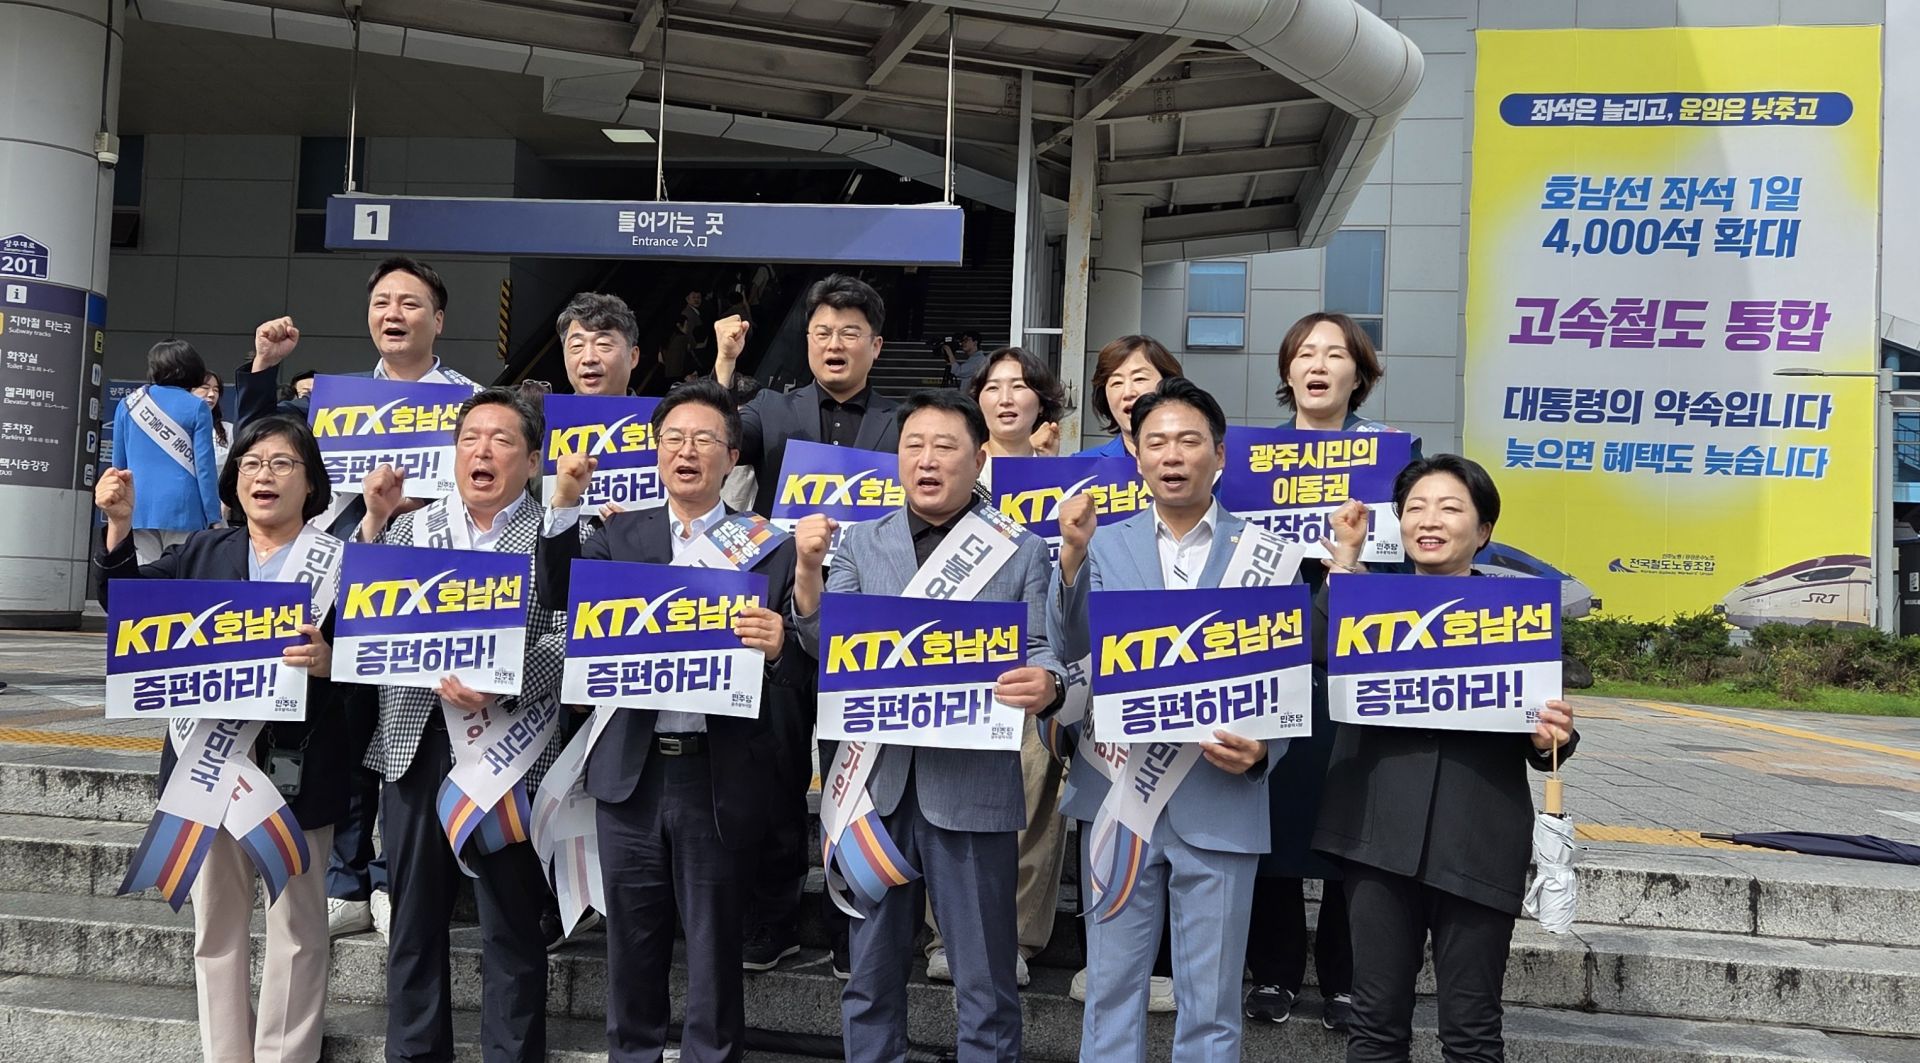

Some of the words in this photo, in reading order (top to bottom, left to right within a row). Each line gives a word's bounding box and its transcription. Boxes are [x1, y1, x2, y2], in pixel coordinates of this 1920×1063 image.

[1531, 98, 1597, 122] 좌석은
[1602, 98, 1674, 122] 늘리고,
[1679, 98, 1746, 122] 운임은
[1751, 96, 1819, 122] 낮추고
[1541, 175, 1653, 211] 호남선
[1660, 176, 1737, 213] 좌석
[1748, 176, 1803, 212] 1일
[366, 209, 379, 235] 1
[618, 211, 695, 233] 들어가는
[705, 212, 724, 235] 곳
[632, 235, 679, 247] Entrance
[683, 235, 708, 248] 入口
[1541, 217, 1704, 259] 4,000석
[1713, 217, 1802, 259] 확대
[4, 239, 36, 249] 상무대로
[1, 255, 37, 275] 201
[10, 315, 40, 328] 지하철
[45, 319, 72, 334] 타는곳
[1508, 297, 1711, 350] 고속철도
[1724, 299, 1833, 353] 통합
[7, 350, 38, 364] 화장실
[4, 386, 55, 401] 엘리베이터
[1503, 386, 1645, 425] 대통령의
[1654, 390, 1832, 430] 약속입니다
[2, 422, 34, 436] 주차장
[312, 397, 409, 438] KTX
[389, 402, 464, 434] 호남선
[548, 413, 638, 461] KTX
[1249, 437, 1378, 473] 광주시민의
[1505, 437, 1595, 471] 늦으면
[1603, 441, 1694, 474] 혜택도
[1704, 445, 1829, 479] 늦습니다
[578, 472, 666, 506] 편하라
[780, 468, 879, 505] KTX
[999, 475, 1099, 524] KTX
[1272, 473, 1350, 504] 이동권
[1630, 558, 1716, 572] 전국철도노동조합
[343, 568, 458, 620] KTX
[436, 575, 522, 613] 호남선
[572, 586, 688, 640] KTX
[666, 595, 760, 632] 호남선
[1801, 592, 1840, 604] SRT
[114, 600, 233, 657] KTX
[212, 603, 304, 645] 호남선
[825, 619, 942, 674] KTX
[922, 624, 1019, 666] 호남선
[1099, 609, 1223, 677] KTX
[1202, 608, 1303, 661] 호남선
[1335, 597, 1465, 657] KTX
[1443, 602, 1552, 648] 호남선
[355, 634, 497, 676] 증편하라!
[133, 663, 278, 712] 증편하라!
[587, 655, 733, 698] 증편하라!
[1356, 669, 1523, 717] 증편하라!
[275, 699, 298, 708] 민주당
[842, 688, 993, 734] 증편하라!
[1121, 676, 1279, 736] 증편하라!
[1525, 710, 1543, 720] 민주
